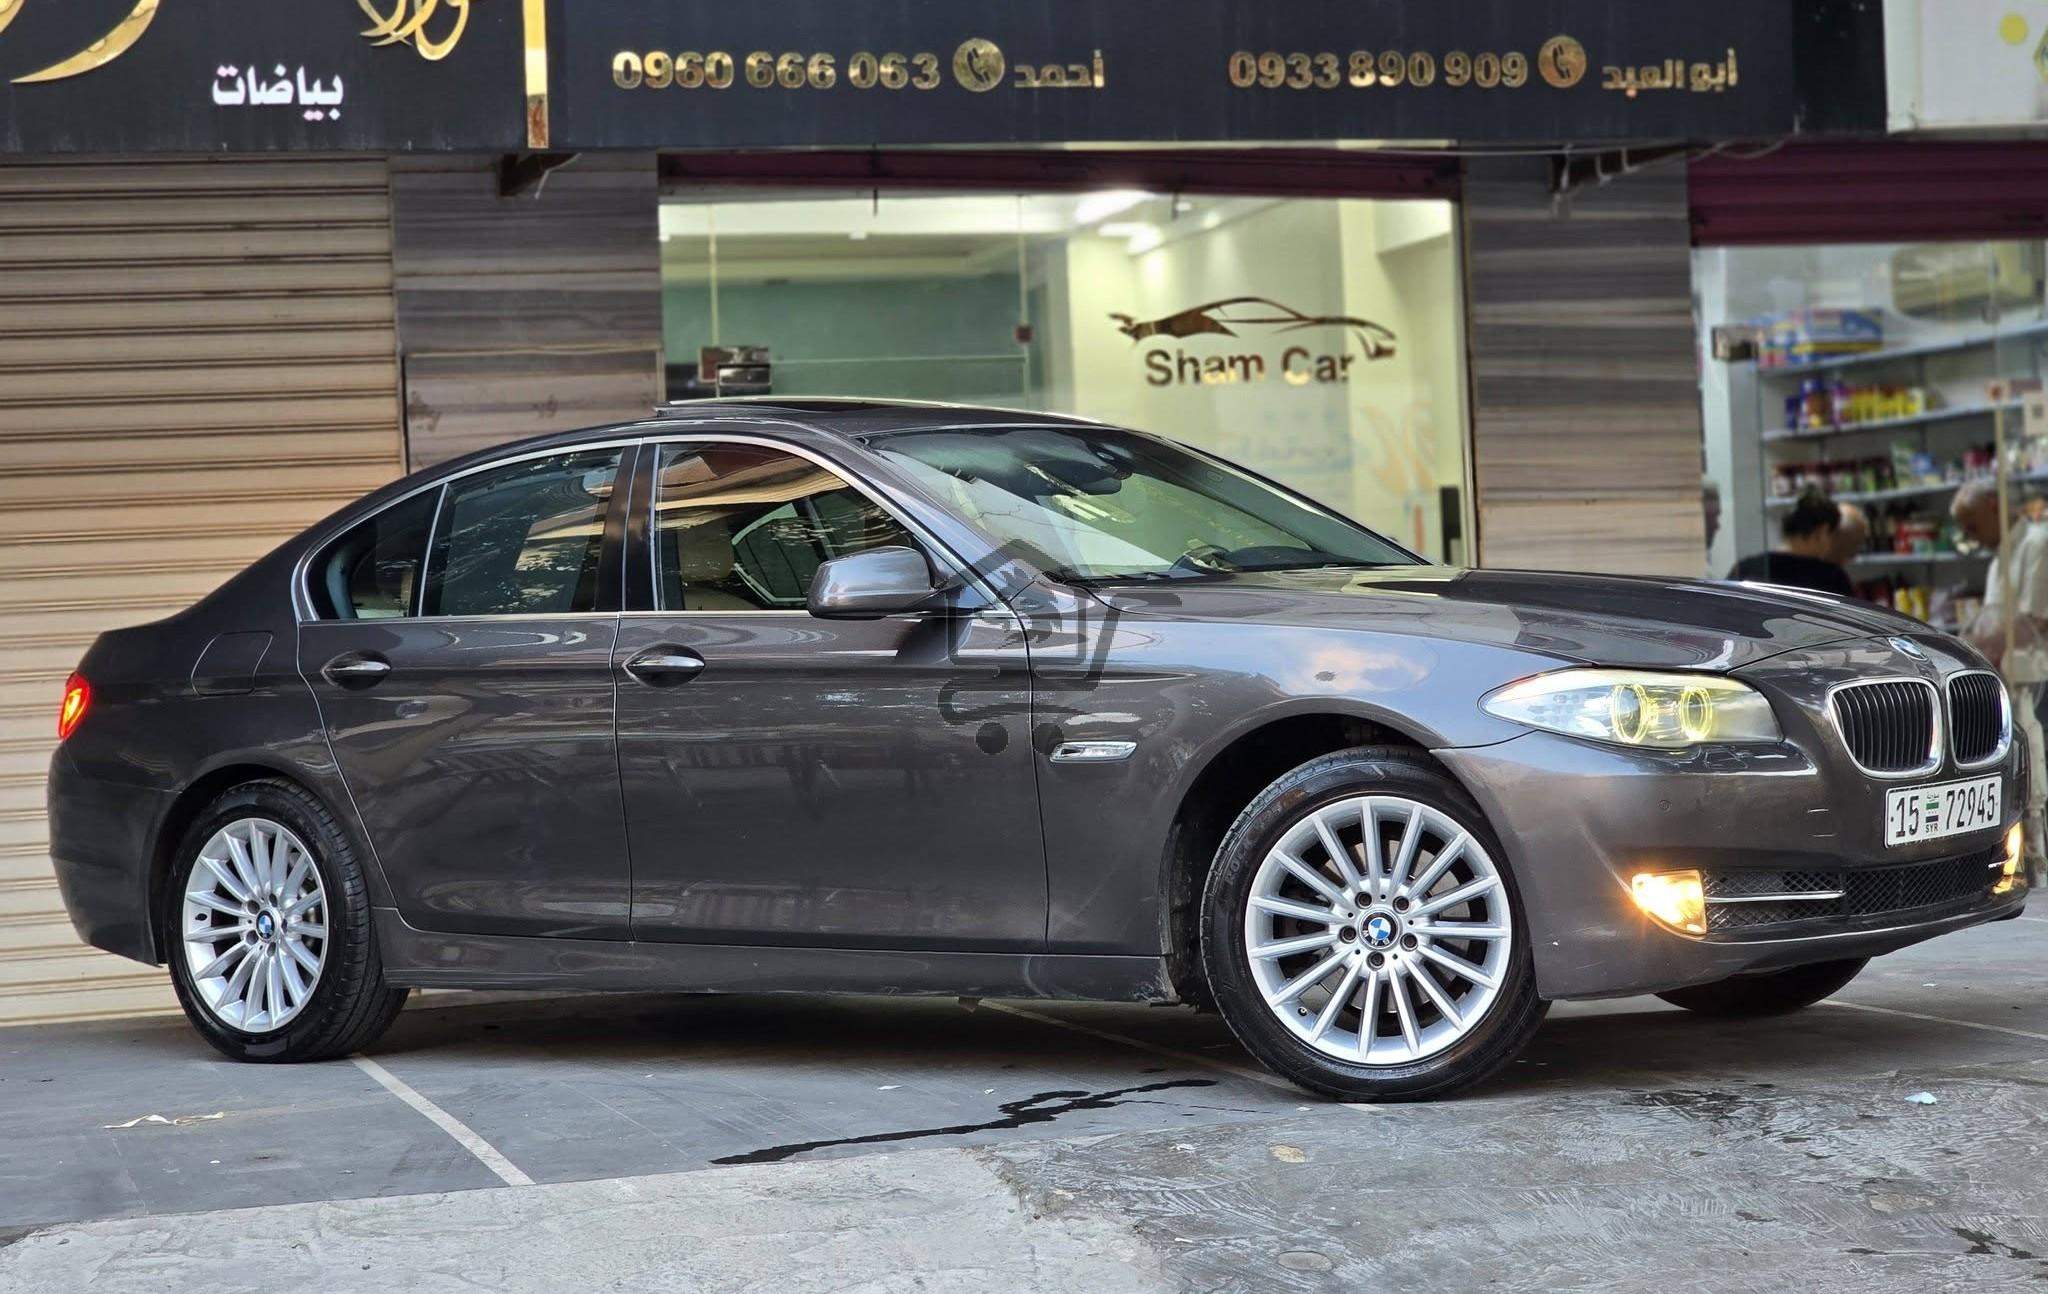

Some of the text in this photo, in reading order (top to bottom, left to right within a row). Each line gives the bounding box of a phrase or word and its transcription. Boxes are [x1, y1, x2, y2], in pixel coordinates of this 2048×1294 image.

[612, 50, 941, 90] 0960 666 063
[1228, 50, 1528, 89] 0933 890 909
[212, 63, 344, 121] بياضات
[1145, 346, 1354, 386] Sham Car
[1896, 783, 1995, 838] 15 SYR 72945
